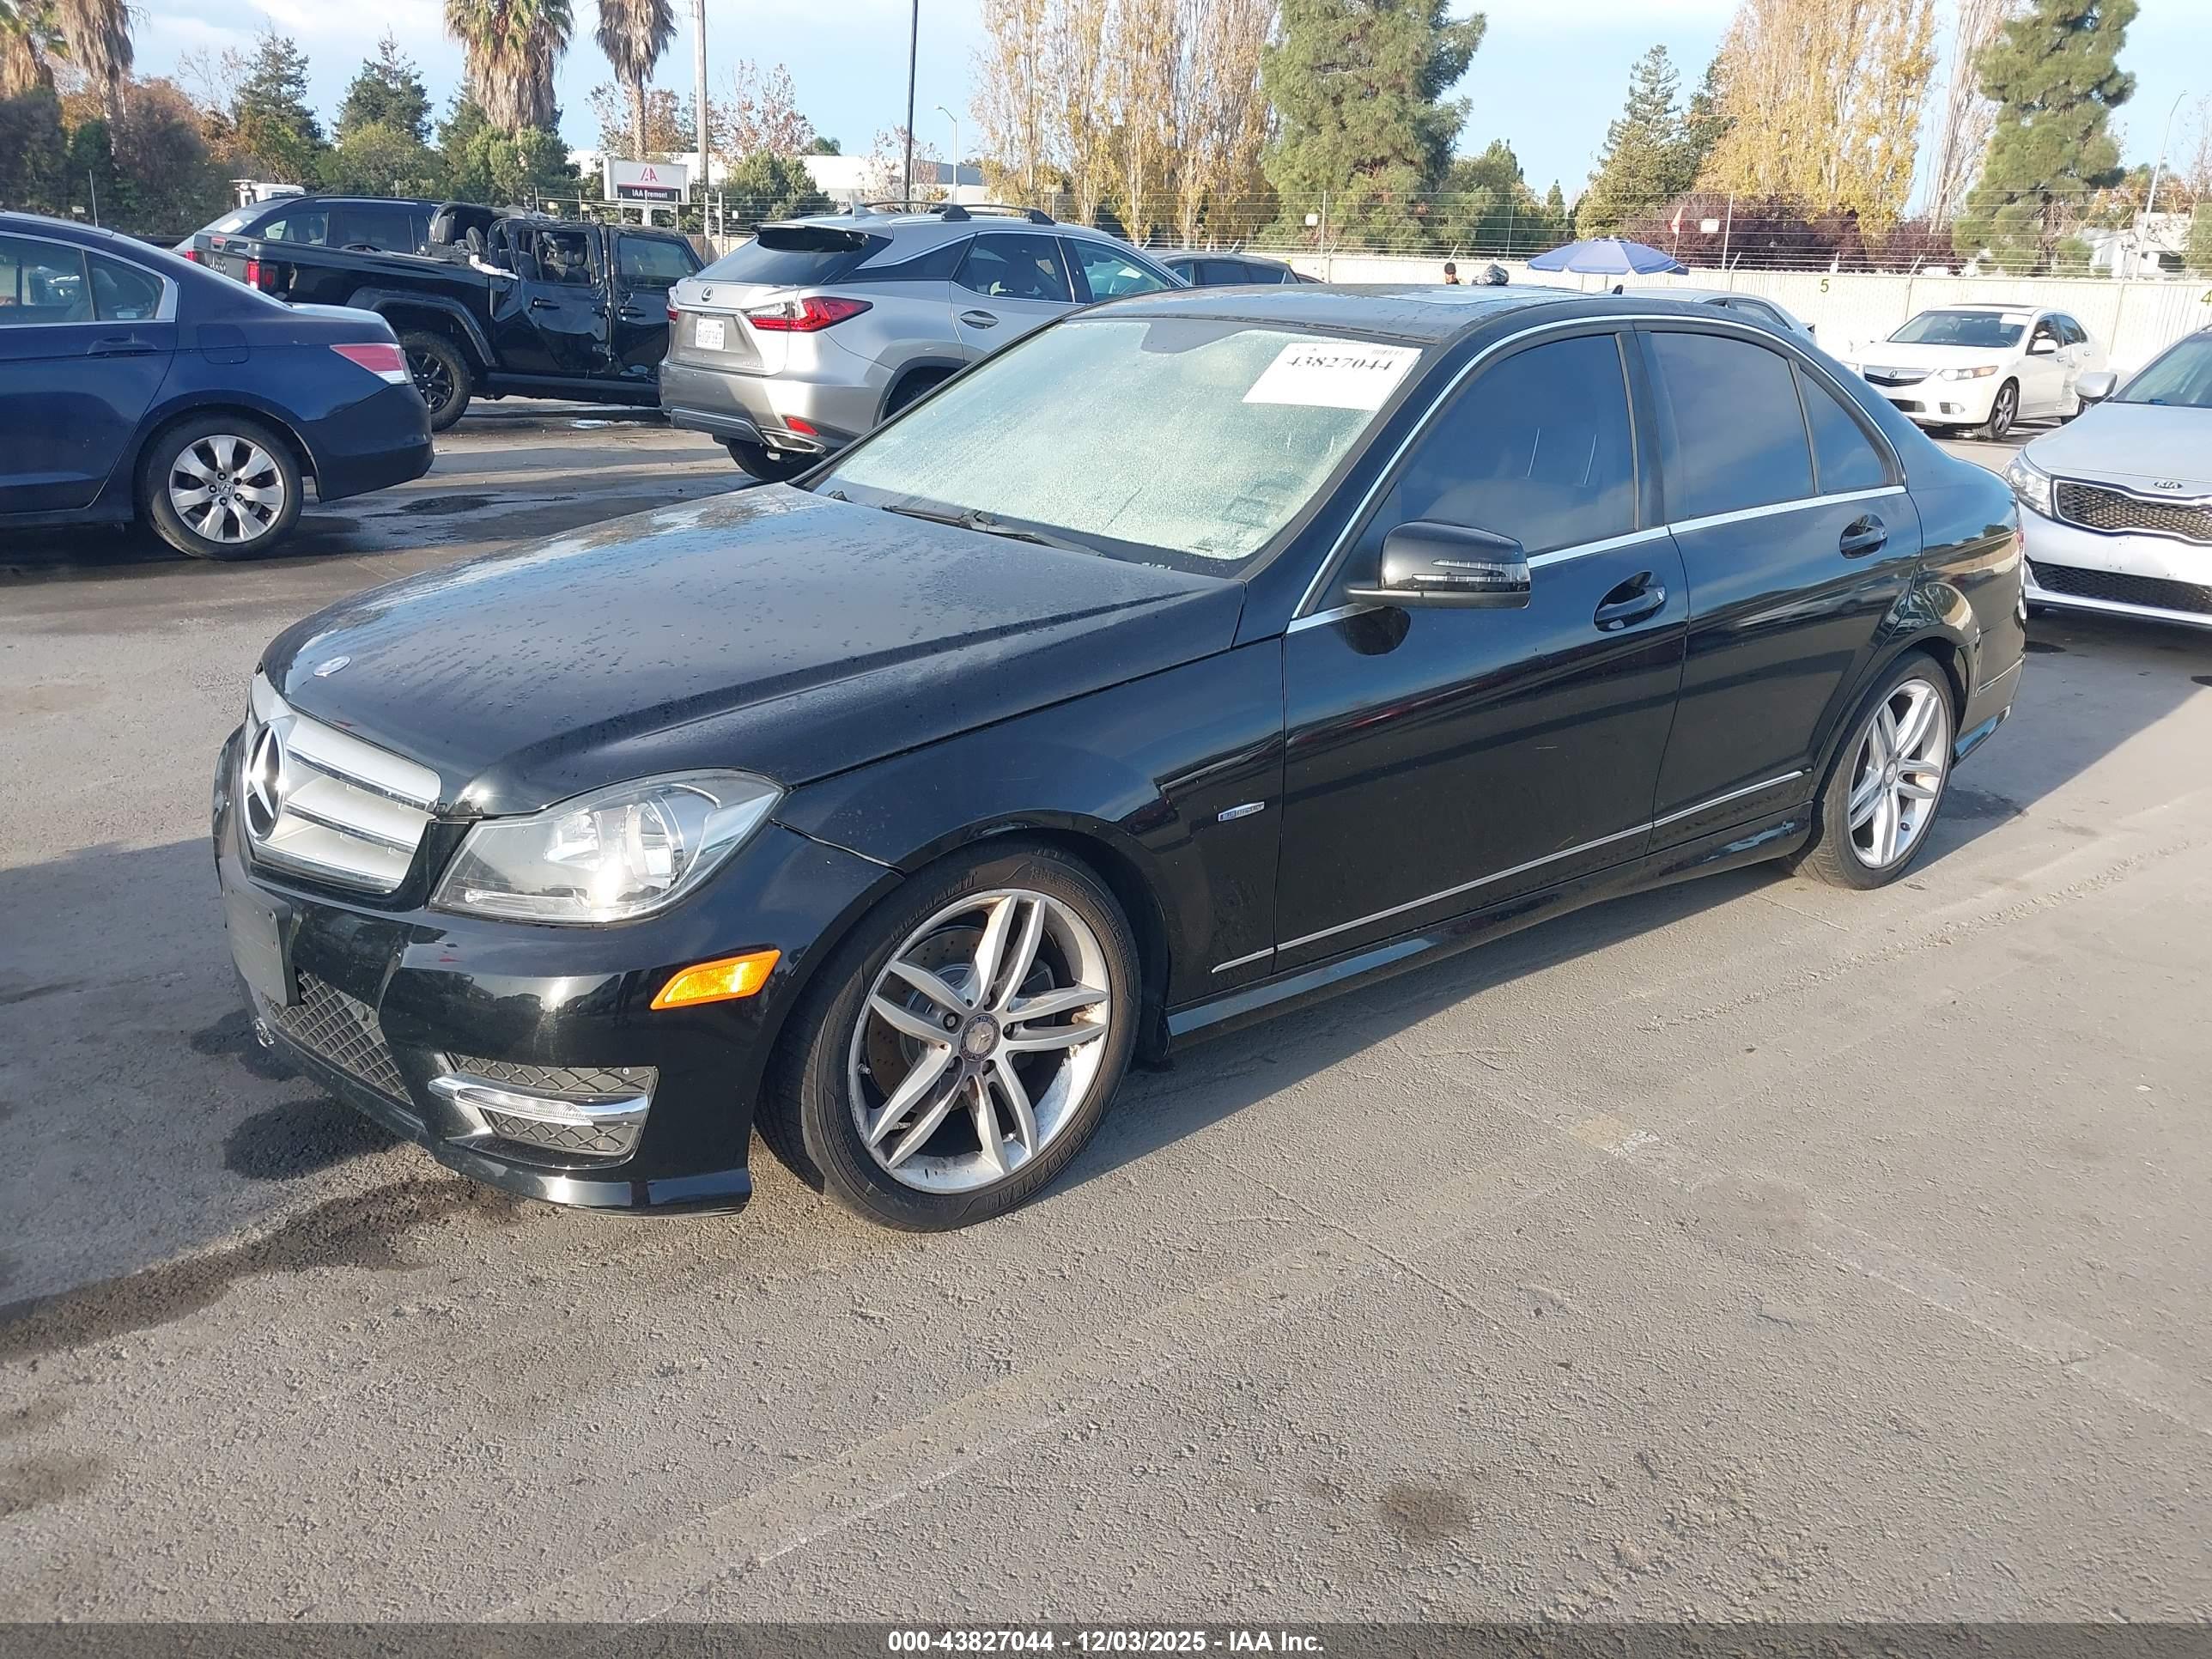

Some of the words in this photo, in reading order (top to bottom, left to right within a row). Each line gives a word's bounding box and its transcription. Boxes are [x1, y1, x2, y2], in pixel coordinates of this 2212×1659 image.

[632, 188, 643, 198] IAA
[1820, 278, 1829, 293] 5
[2200, 290, 2212, 307] 4
[1286, 356, 1393, 370] 43827044
[2154, 480, 2180, 490] KIA
